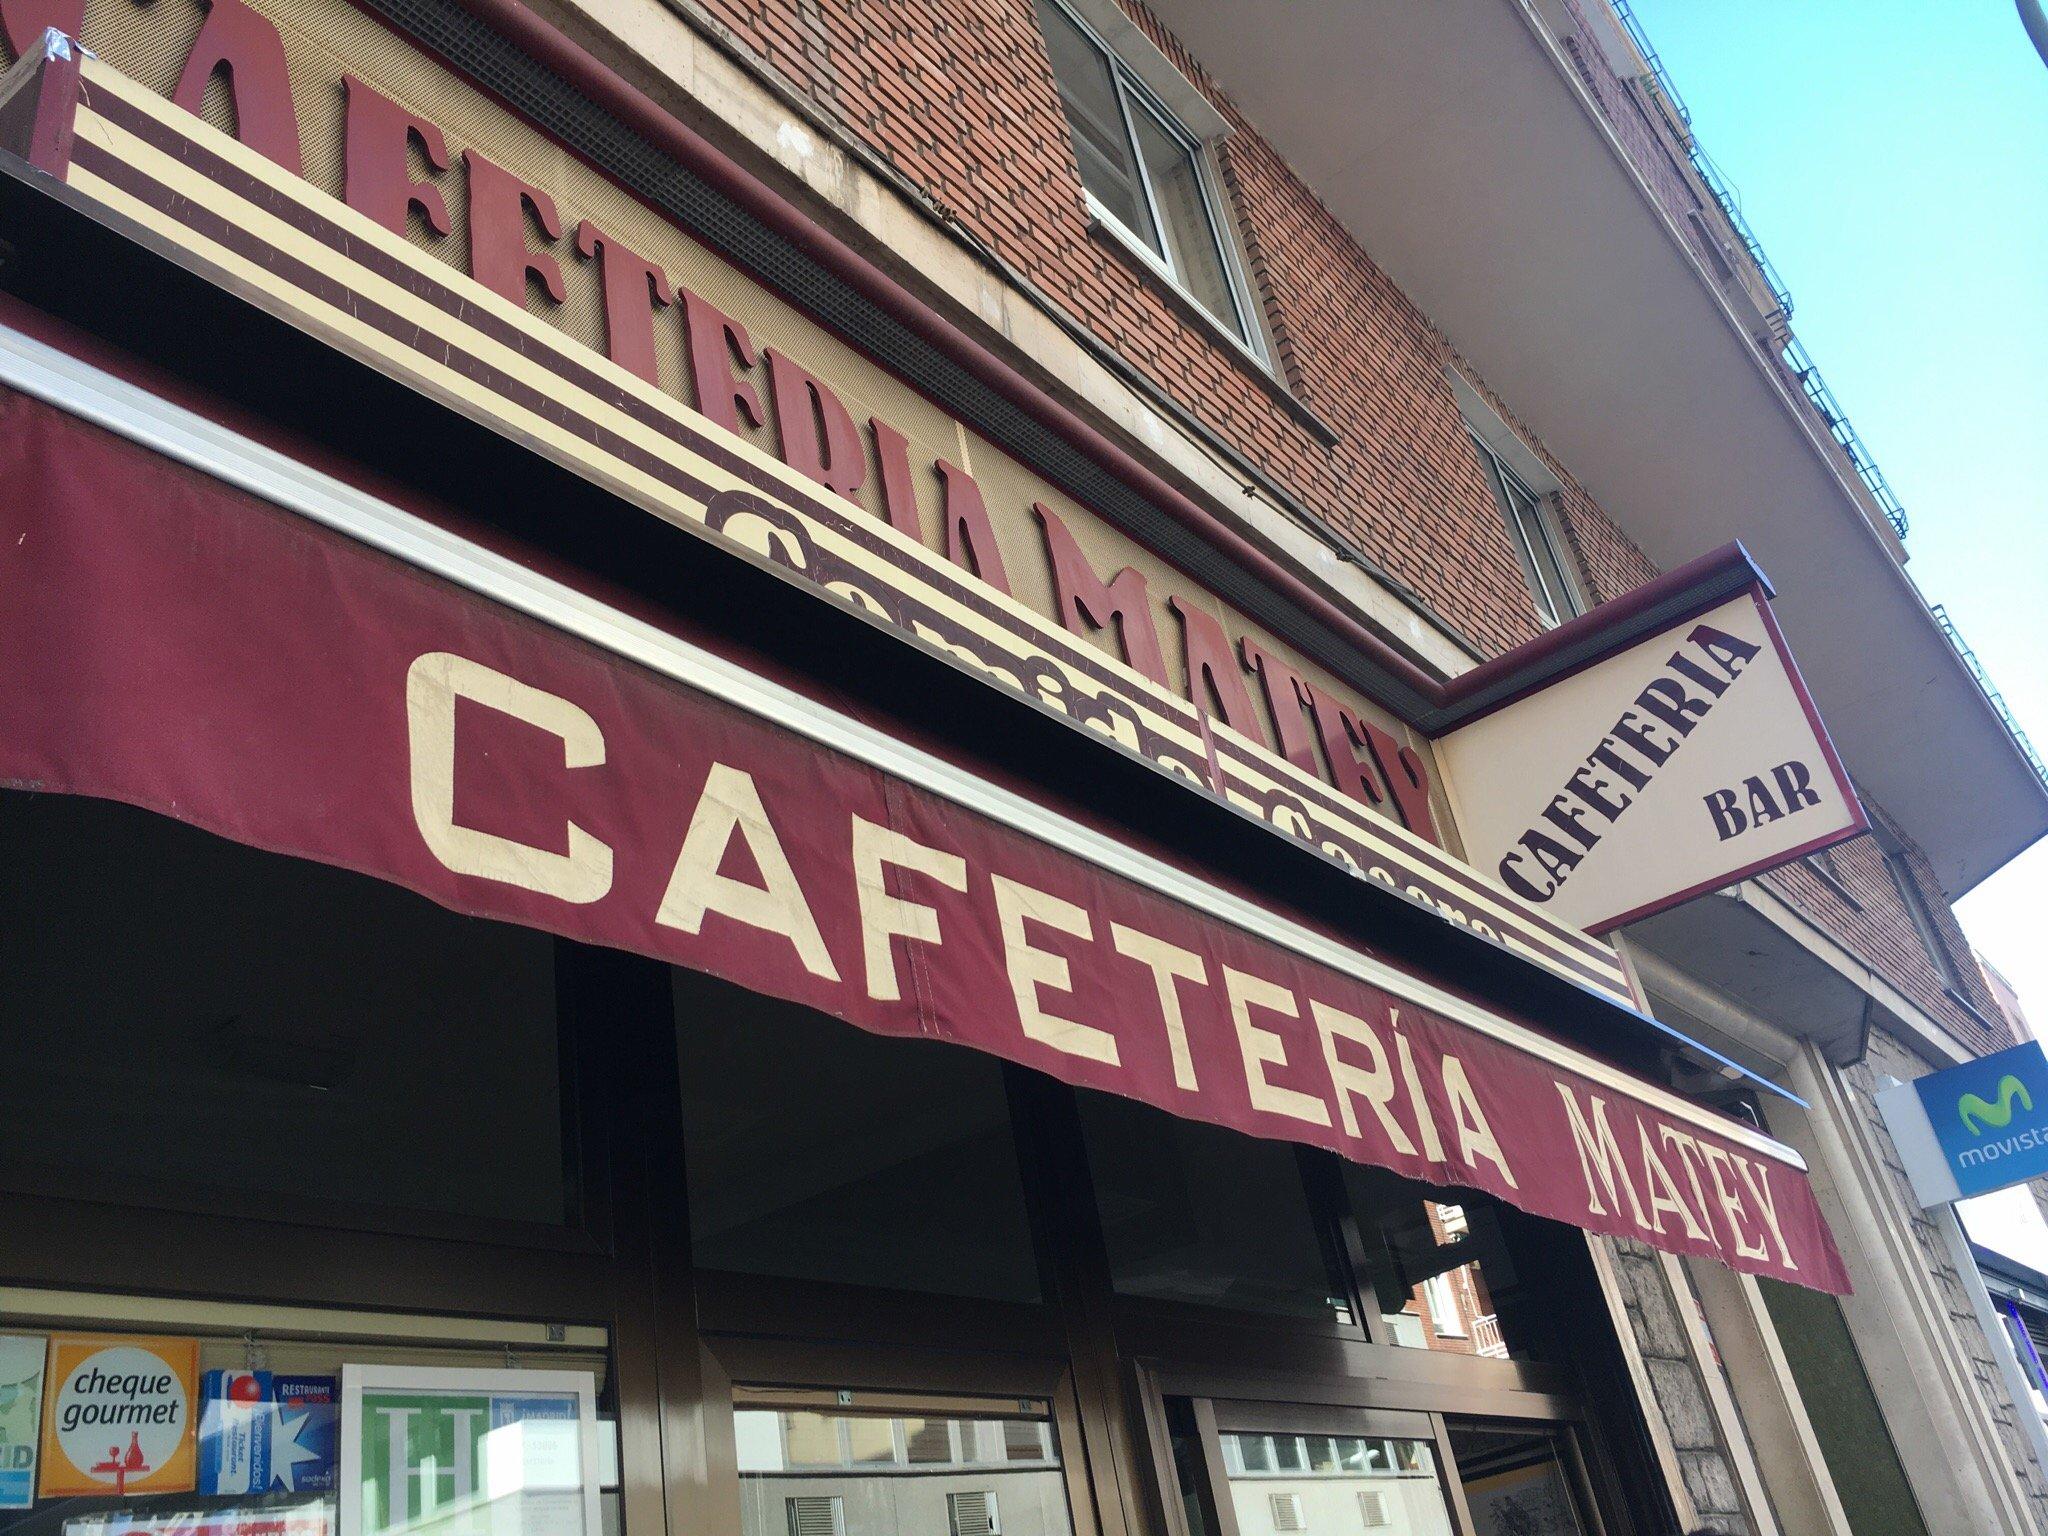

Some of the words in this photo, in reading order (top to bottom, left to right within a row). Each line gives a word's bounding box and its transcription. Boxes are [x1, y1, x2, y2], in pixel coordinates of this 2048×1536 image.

[1498, 624, 1762, 903] CAFETERIA
[1702, 760, 1822, 842] BAR
[406, 651, 1518, 1190] CAFETERÍA
[1555, 1081, 1799, 1270] MATEY
[61, 1399, 179, 1432] gourmet
[74, 1367, 172, 1400] cheque
